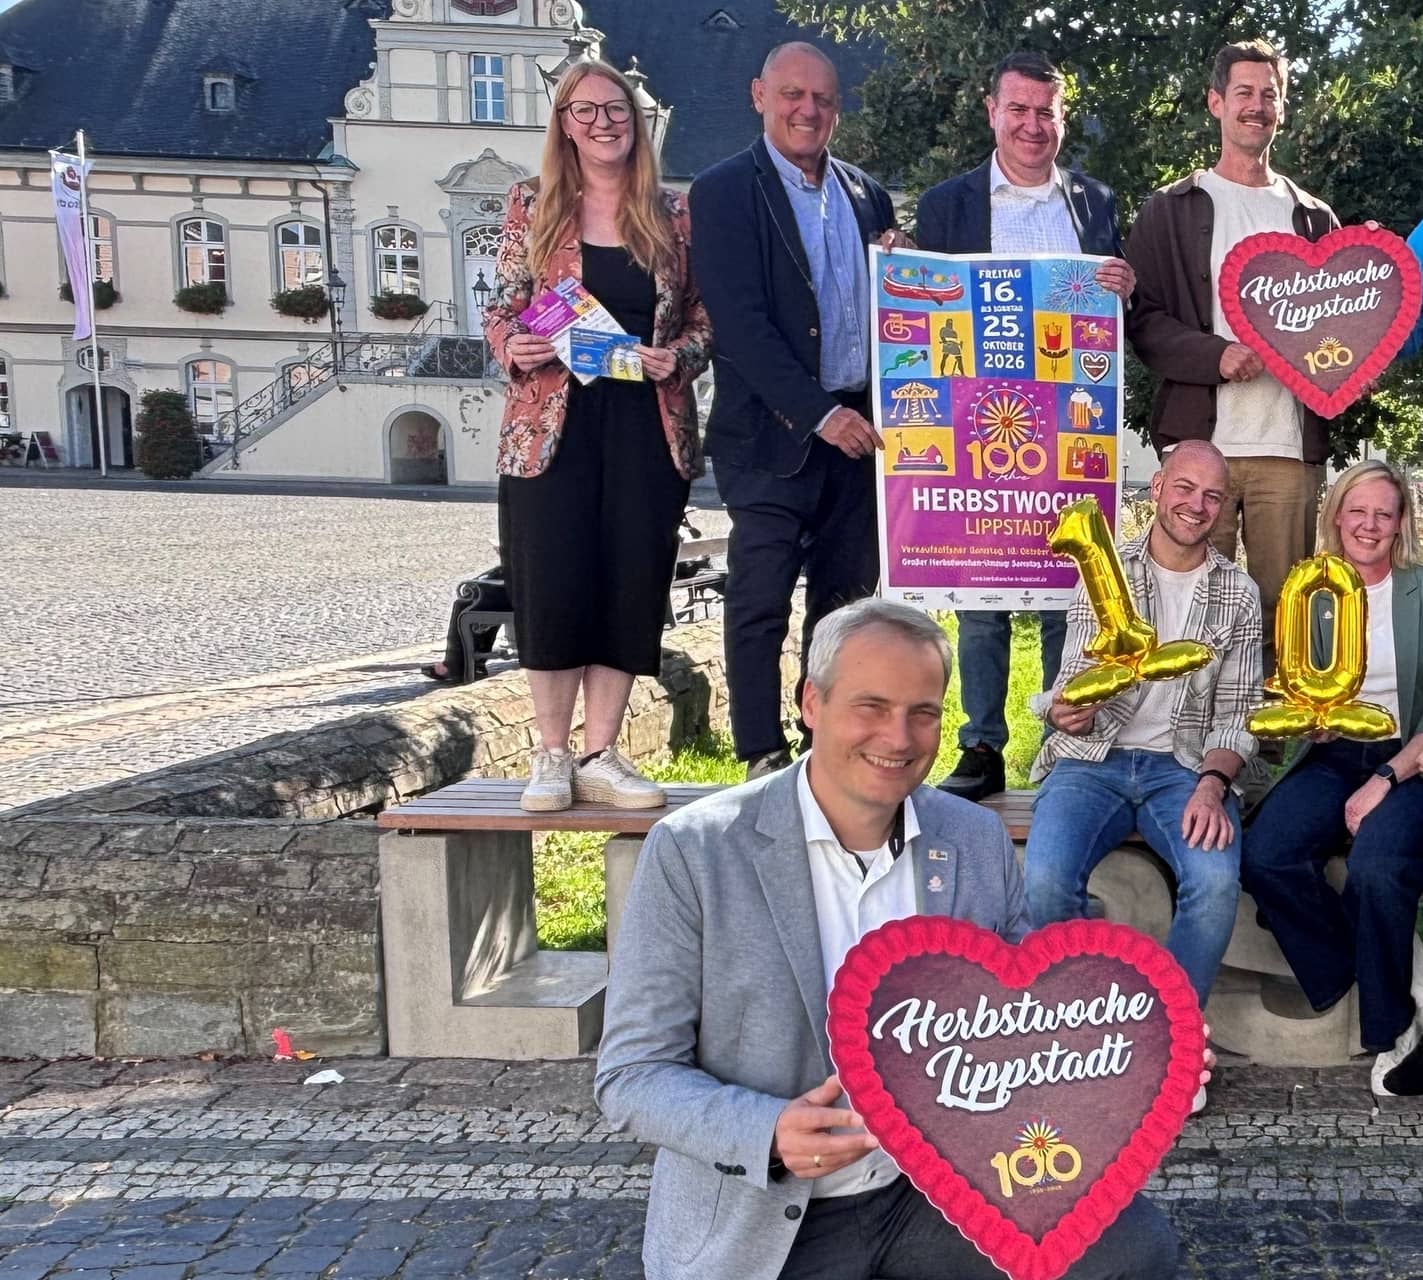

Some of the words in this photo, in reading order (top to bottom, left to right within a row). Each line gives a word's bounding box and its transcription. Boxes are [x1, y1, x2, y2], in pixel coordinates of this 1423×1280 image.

[979, 269, 1022, 279] FREITAG
[1241, 259, 1393, 304] Herbstwoche
[979, 281, 1022, 302] 16.
[1269, 287, 1381, 332] Lippstadt
[983, 315, 1025, 338] 25.
[983, 341, 1025, 351] OKTOBER
[984, 353, 1025, 369] 2026
[1304, 346, 1353, 375] 100
[966, 440, 1047, 480] 100
[912, 487, 1095, 515] HERBSTWOC
[965, 518, 1052, 536] LIPPSTADT
[872, 982, 1154, 1054] Herbstwoche
[925, 1032, 1133, 1112] Lippstadt
[990, 1144, 1082, 1198] 100
